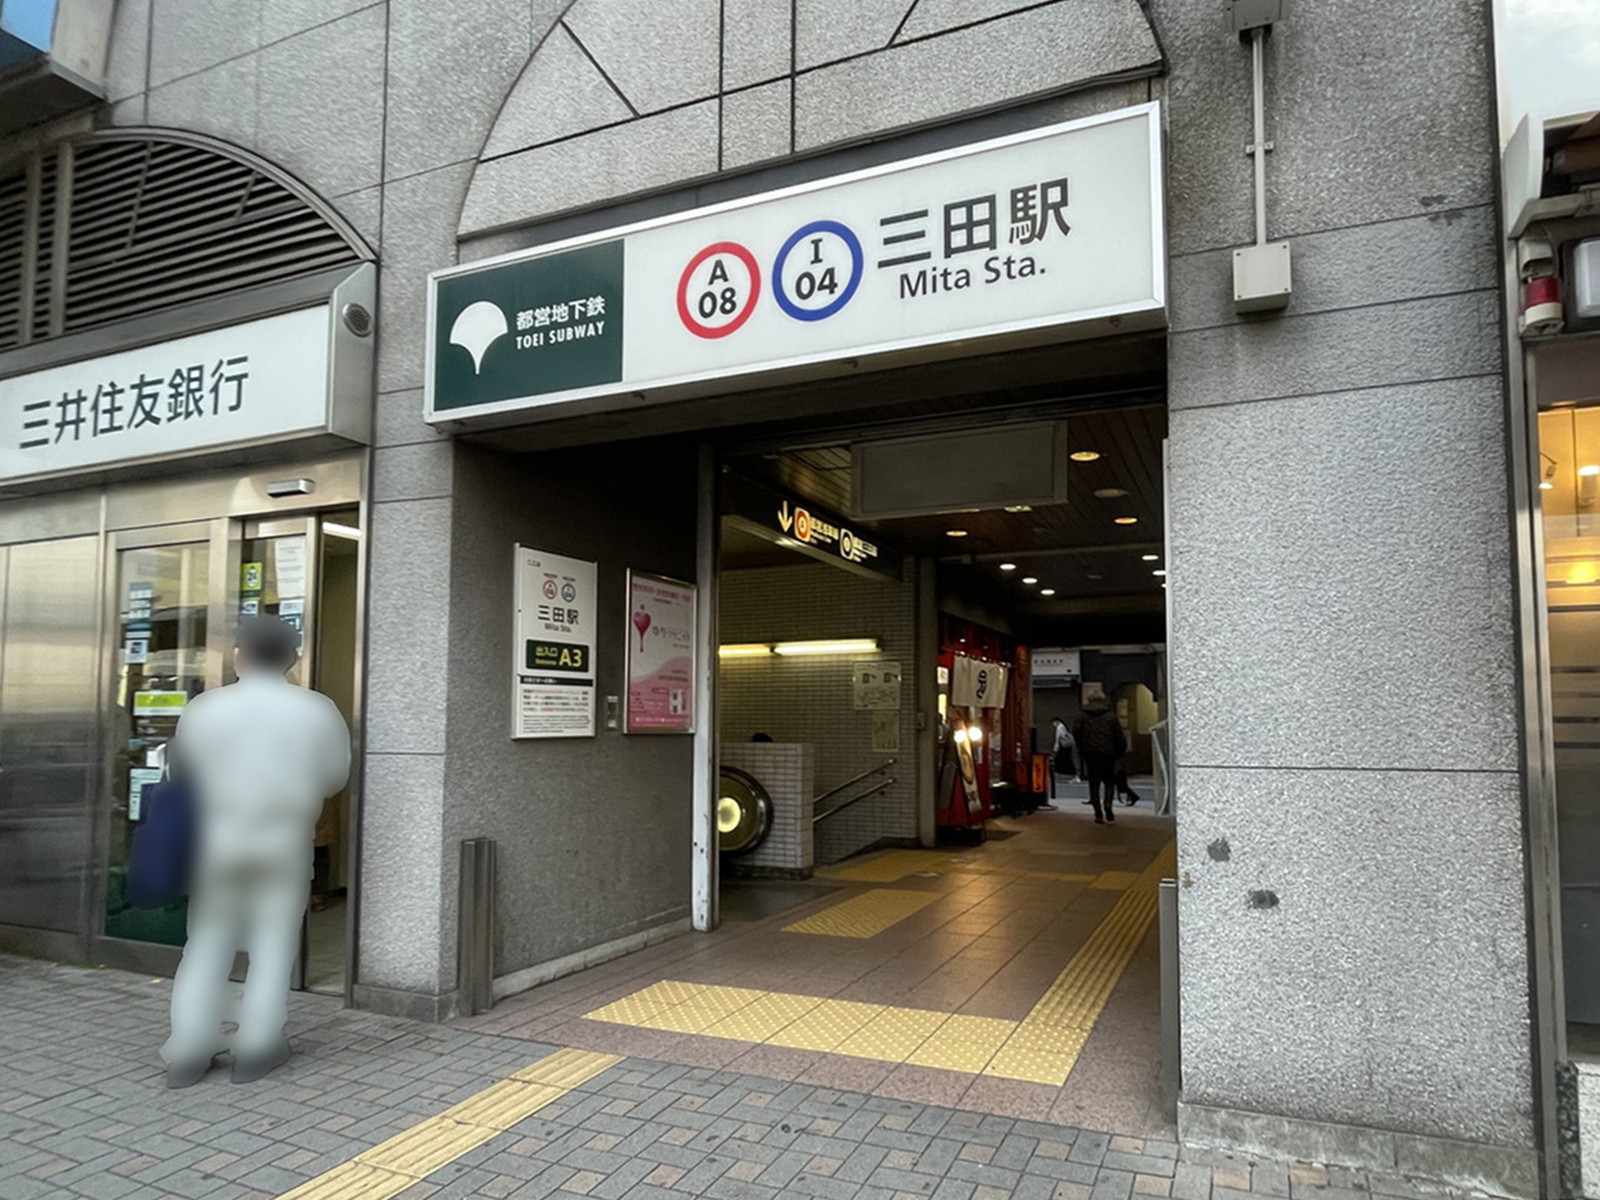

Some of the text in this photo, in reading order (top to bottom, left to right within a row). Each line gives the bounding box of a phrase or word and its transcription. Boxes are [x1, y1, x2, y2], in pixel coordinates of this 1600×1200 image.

[878, 177, 1071, 269] 三田駅
[810, 238, 823, 265] I
[708, 259, 729, 286] A
[795, 267, 838, 301] 04
[900, 255, 1046, 299] Mita Sta.
[516, 295, 606, 331] 都営地下鉄
[697, 287, 737, 319] 08
[516, 321, 605, 350] TOEI SUBWAY
[19, 356, 249, 449] 三井住友銀行
[538, 604, 579, 625] 三田駅
[559, 648, 582, 667] A3
